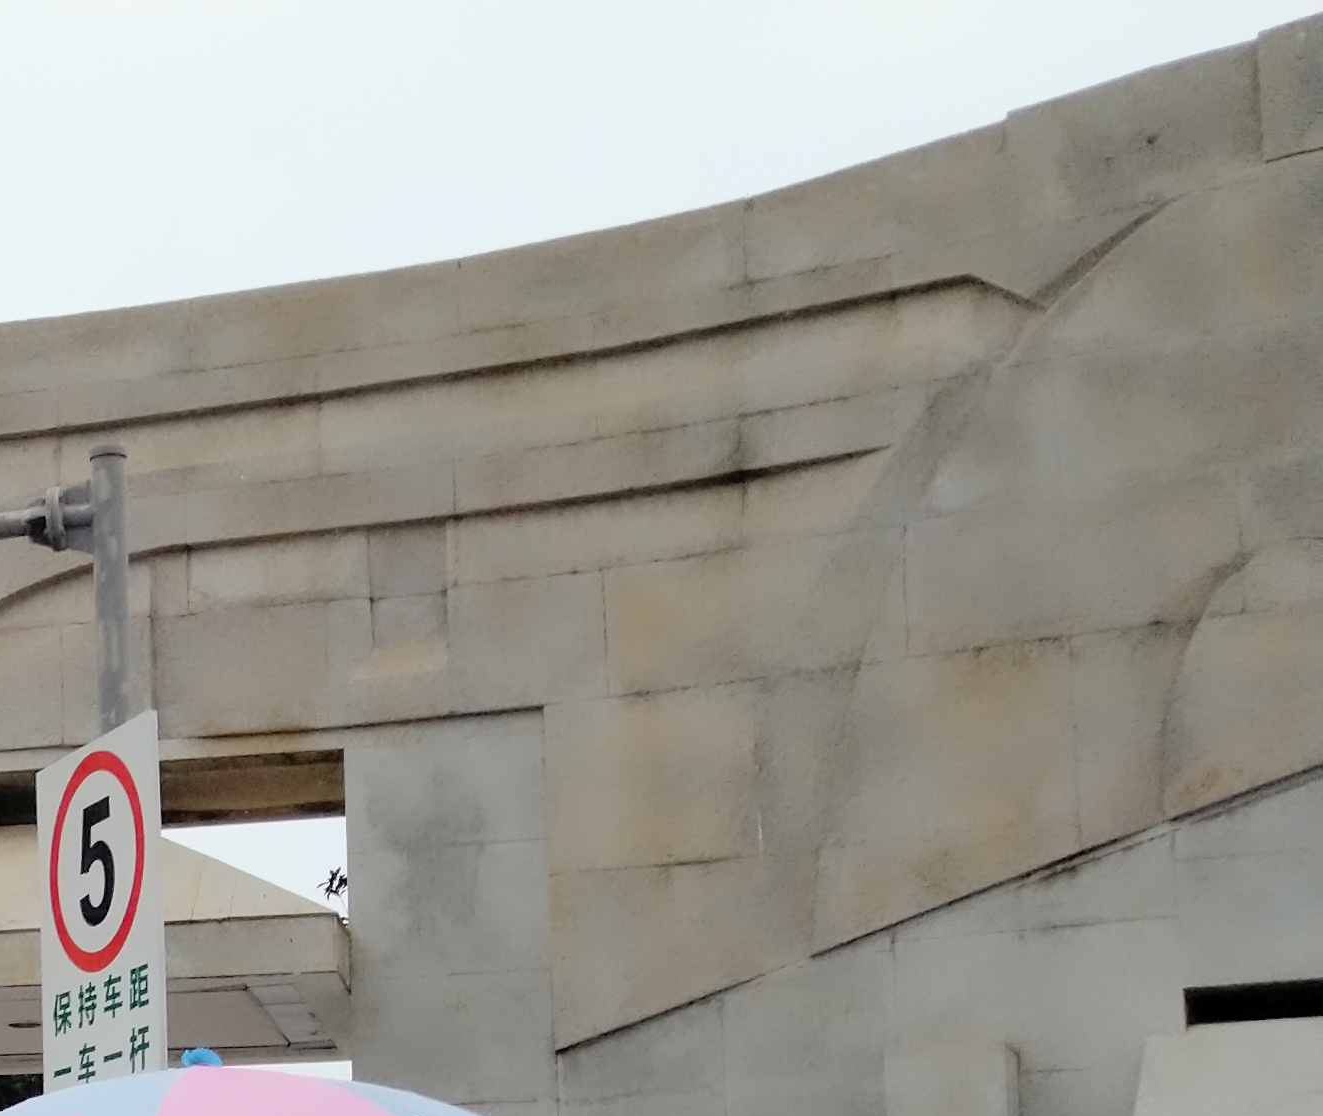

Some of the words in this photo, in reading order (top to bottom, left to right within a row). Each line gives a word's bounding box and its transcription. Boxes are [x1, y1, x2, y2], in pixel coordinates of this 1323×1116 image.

[79, 795, 115, 926] 5
[52, 962, 150, 1037] 保持车距
[53, 1024, 150, 1084] 一车一杆
